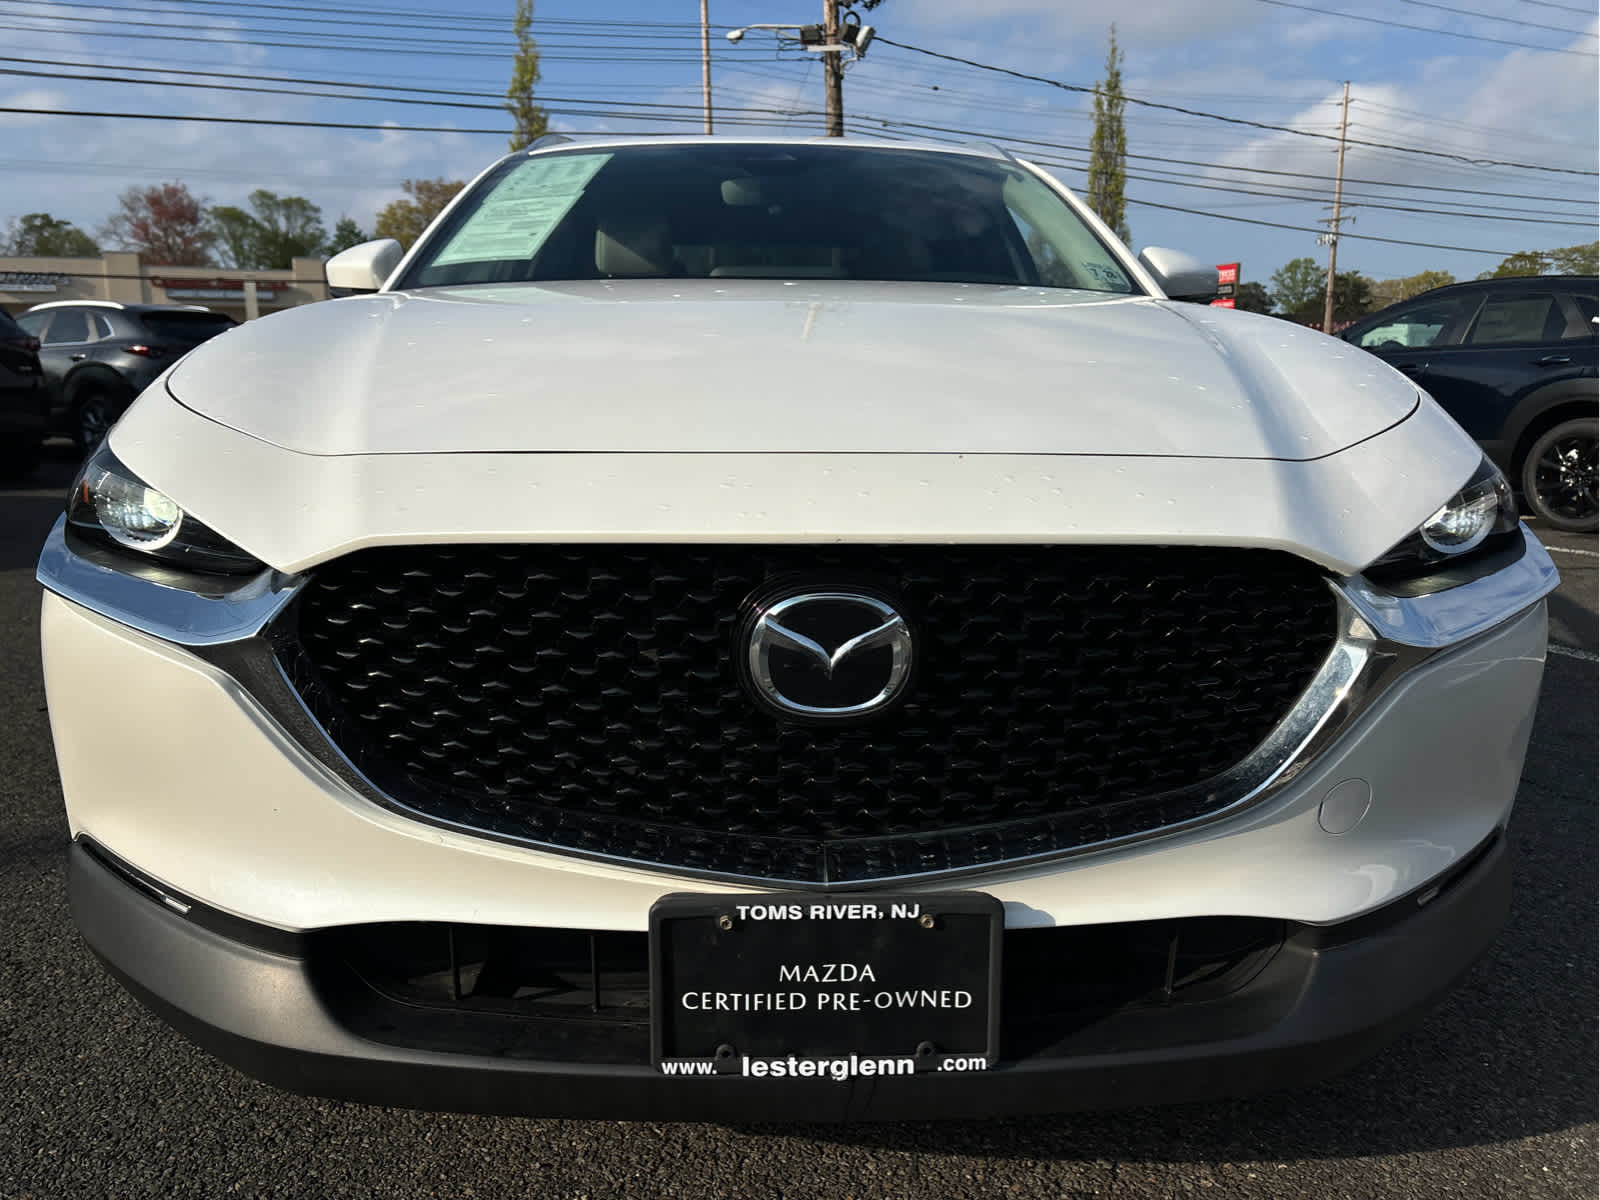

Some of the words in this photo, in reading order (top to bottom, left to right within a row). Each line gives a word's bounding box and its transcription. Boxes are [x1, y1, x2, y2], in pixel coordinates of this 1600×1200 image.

[736, 905, 803, 920] TOMS
[809, 904, 884, 920] RIVER,
[891, 903, 920, 919] NJ
[779, 963, 876, 983] MAZDA
[681, 991, 807, 1011] CERTIFIED
[817, 990, 972, 1011] PRE-OWNED
[661, 1061, 717, 1076] www.
[742, 1056, 915, 1081] lesterglenn
[937, 1057, 987, 1072] .com
